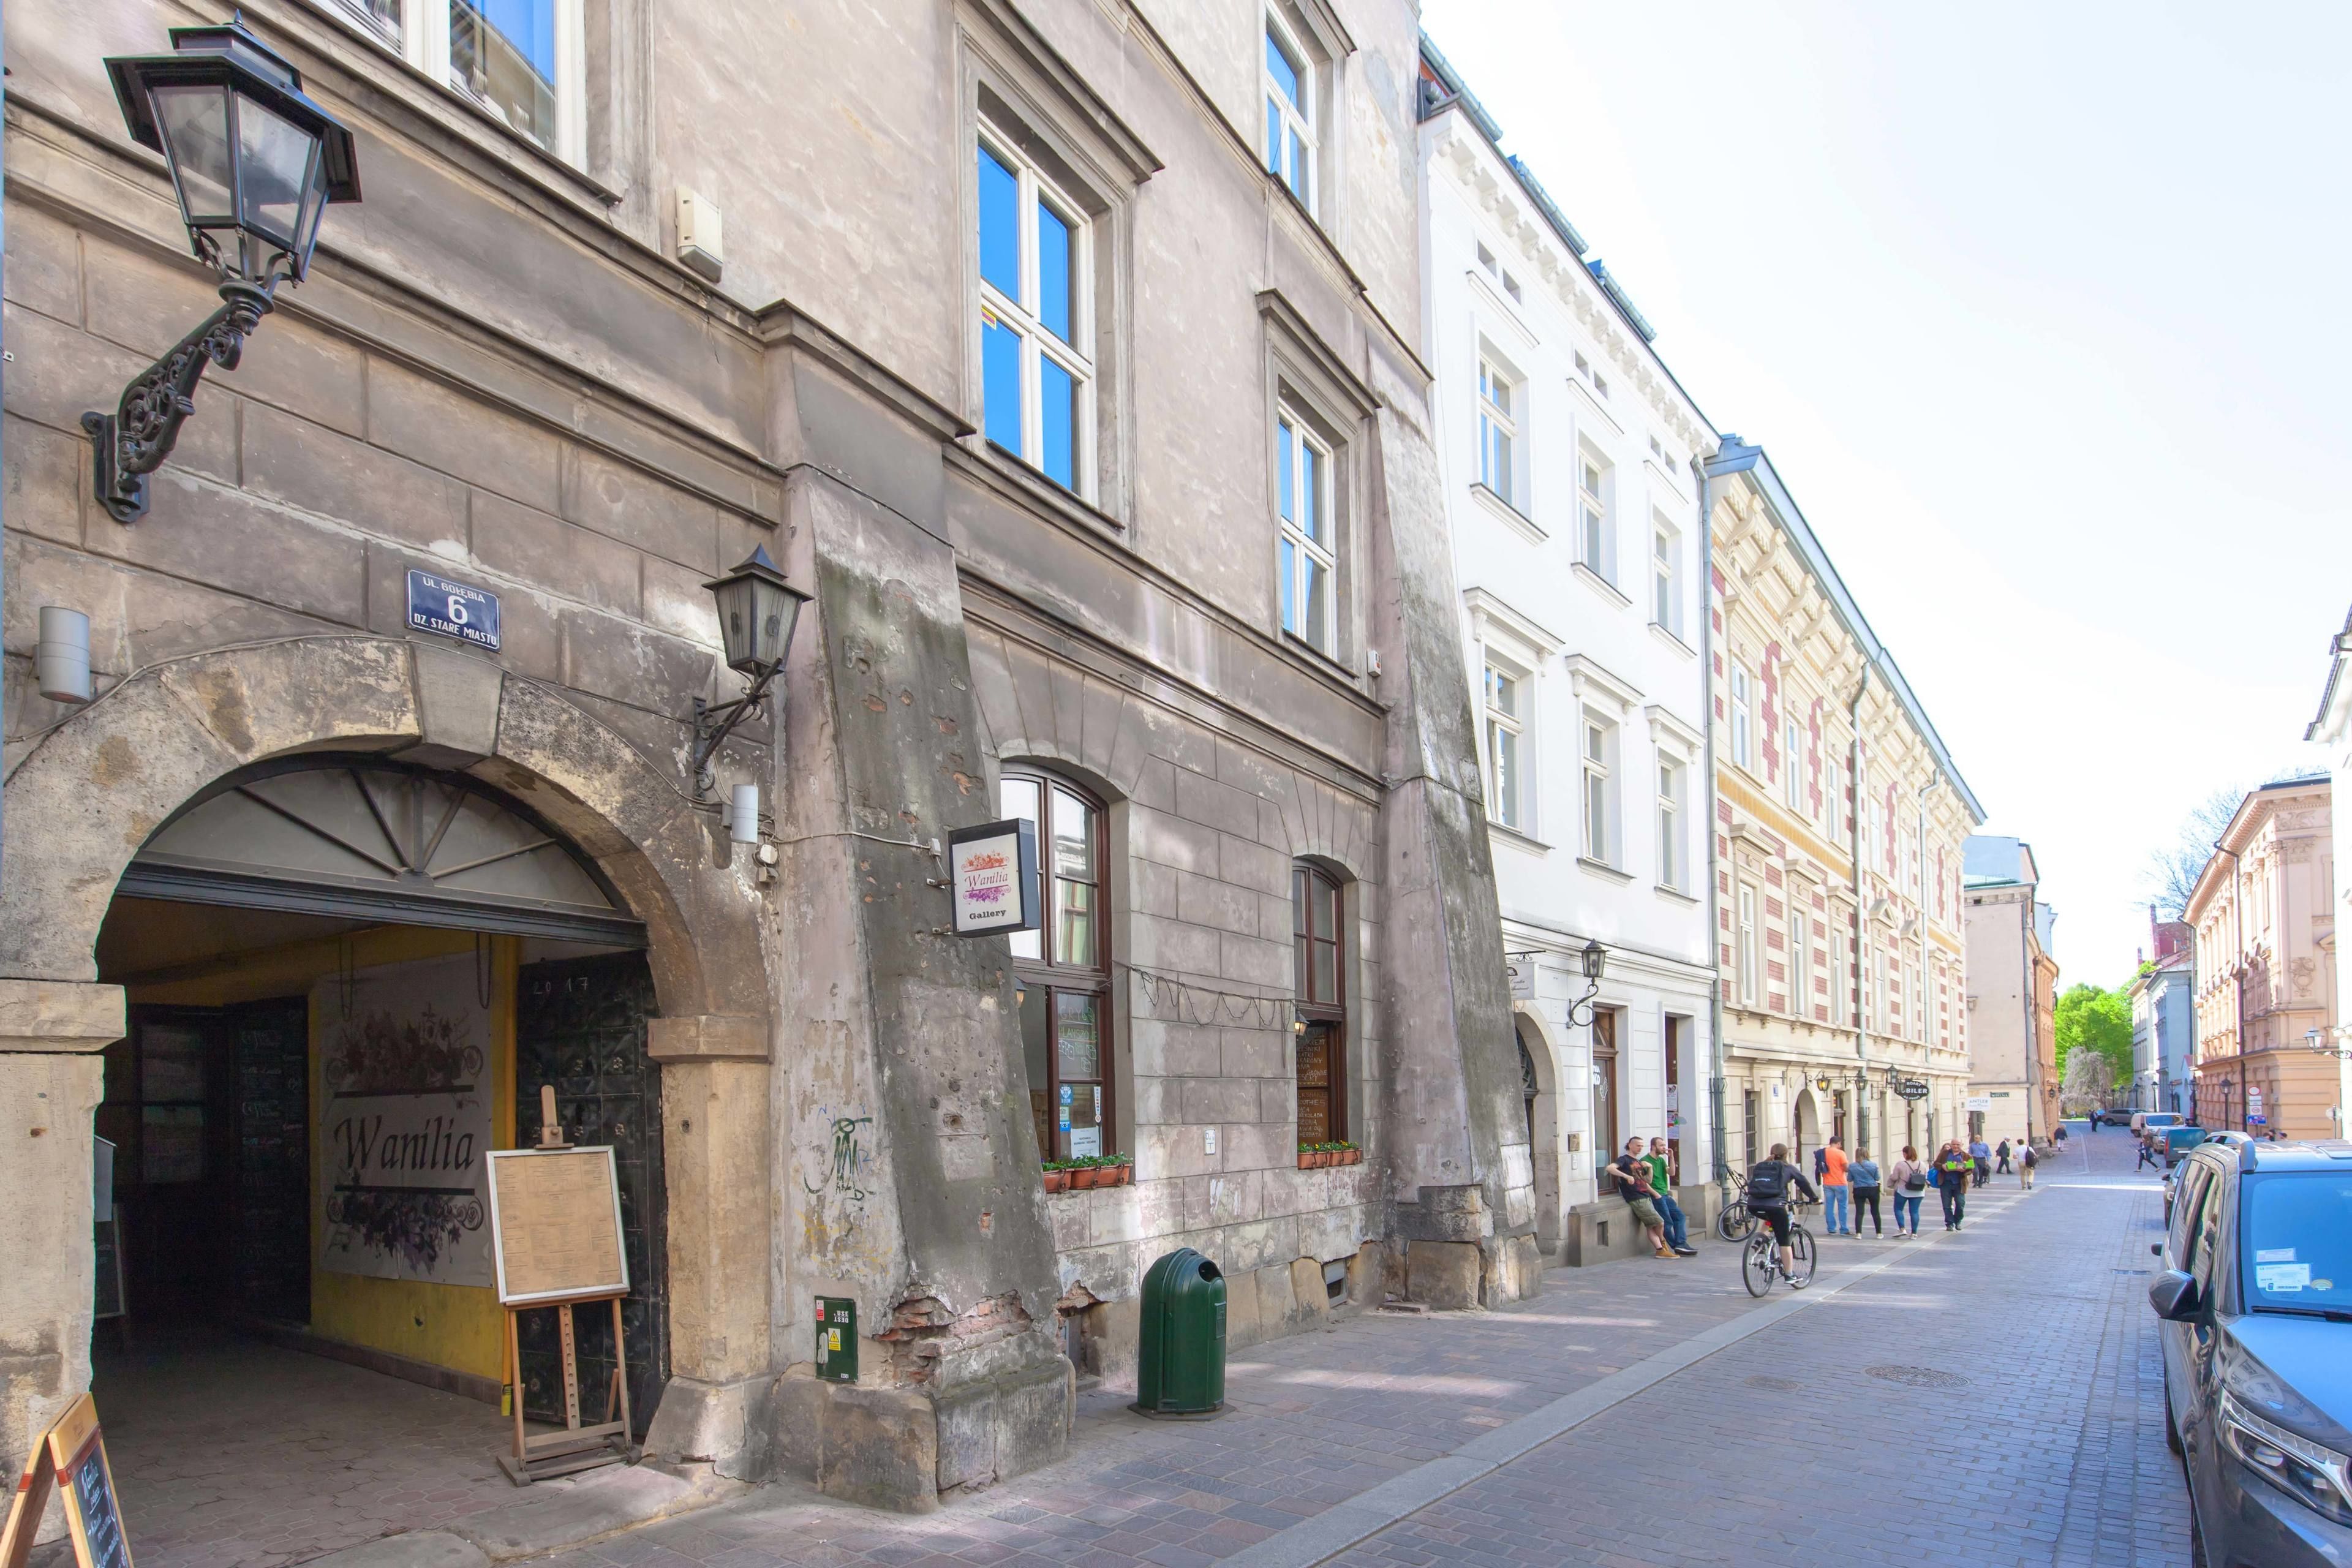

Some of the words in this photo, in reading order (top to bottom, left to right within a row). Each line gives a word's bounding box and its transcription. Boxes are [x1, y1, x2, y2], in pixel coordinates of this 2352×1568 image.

[423, 577, 439, 589] UL.
[441, 582, 485, 603] GOŁĘBIA
[448, 595, 468, 625] 6
[414, 613, 429, 625] DZ.
[431, 617, 460, 635] STARE
[464, 627, 497, 645] MIASTO
[964, 872, 1008, 888] Wanilia
[969, 909, 1006, 920] Gallery
[334, 1115, 474, 1170] Wanilia
